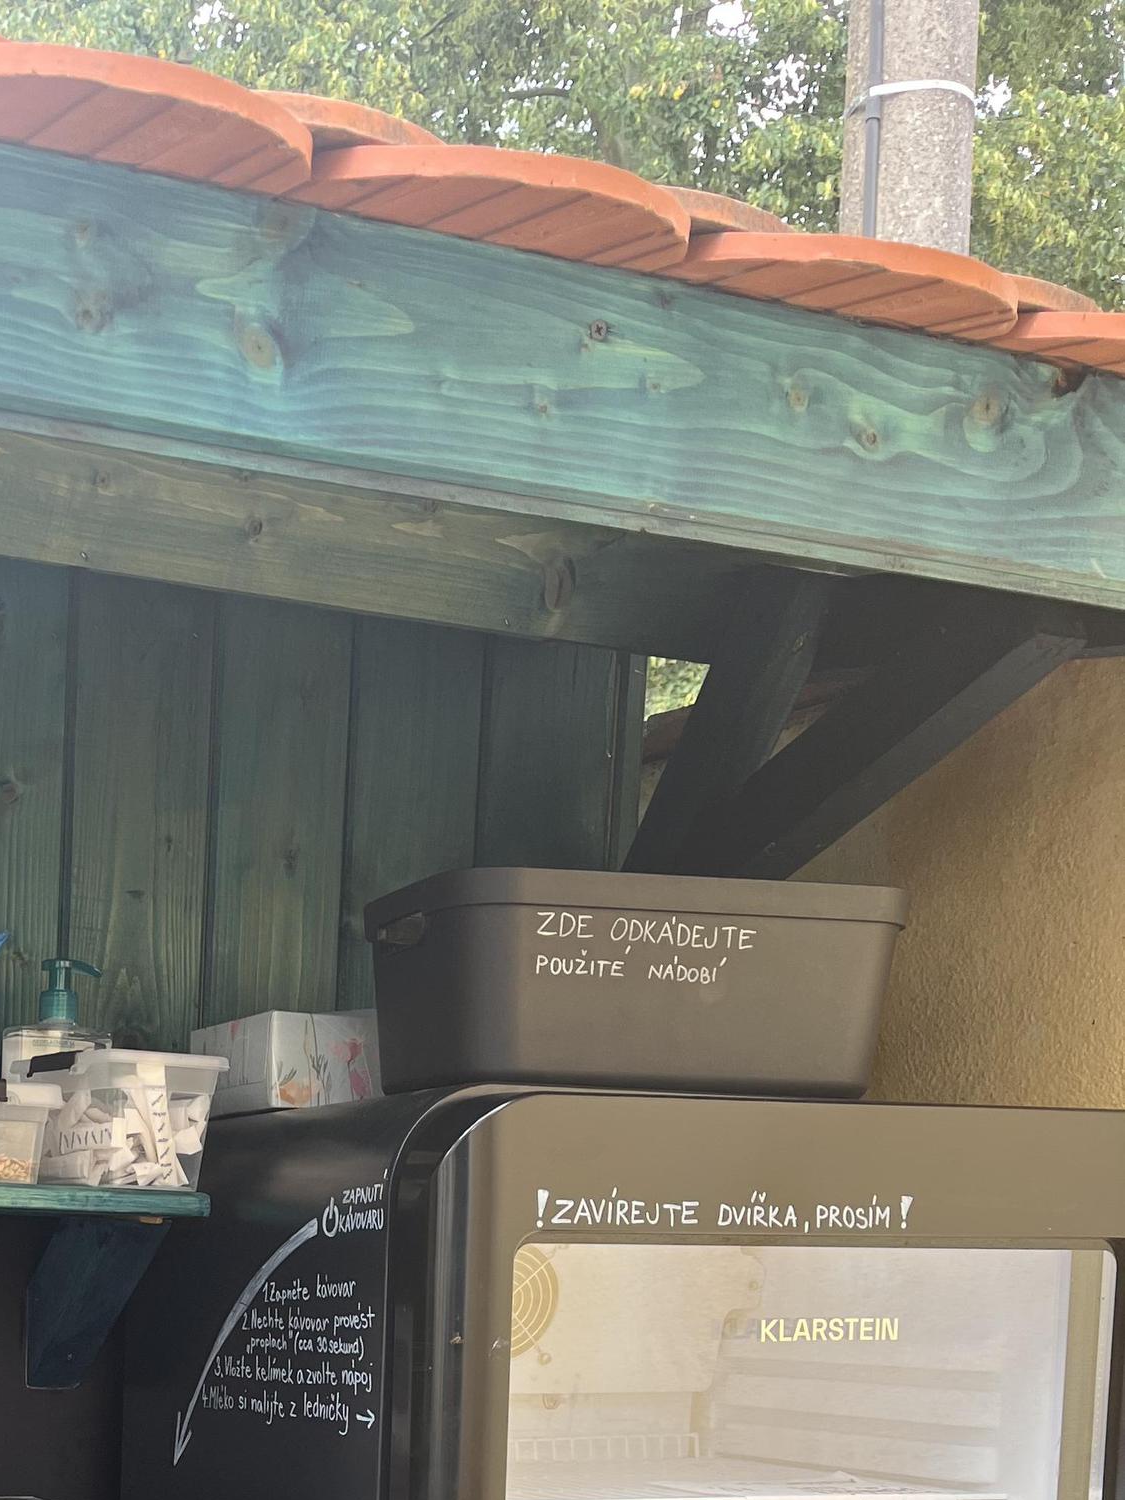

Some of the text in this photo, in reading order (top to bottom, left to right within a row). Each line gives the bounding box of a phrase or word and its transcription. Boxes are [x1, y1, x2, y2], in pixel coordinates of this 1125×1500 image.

[536, 912, 594, 939] ZDE
[536, 945, 728, 985] POUŽITÉ NÁDOBÍ
[338, 1207, 384, 1233] KÁVOVARU
[316, 1274, 357, 1299] kávovar
[288, 1307, 329, 1333] kávovar
[333, 1302, 376, 1335] provést
[760, 1317, 900, 1342] KLARSTEIN
[255, 1355, 294, 1384] kelímek
[341, 1358, 374, 1395] nápoj
[303, 1391, 349, 1436] ledničky
